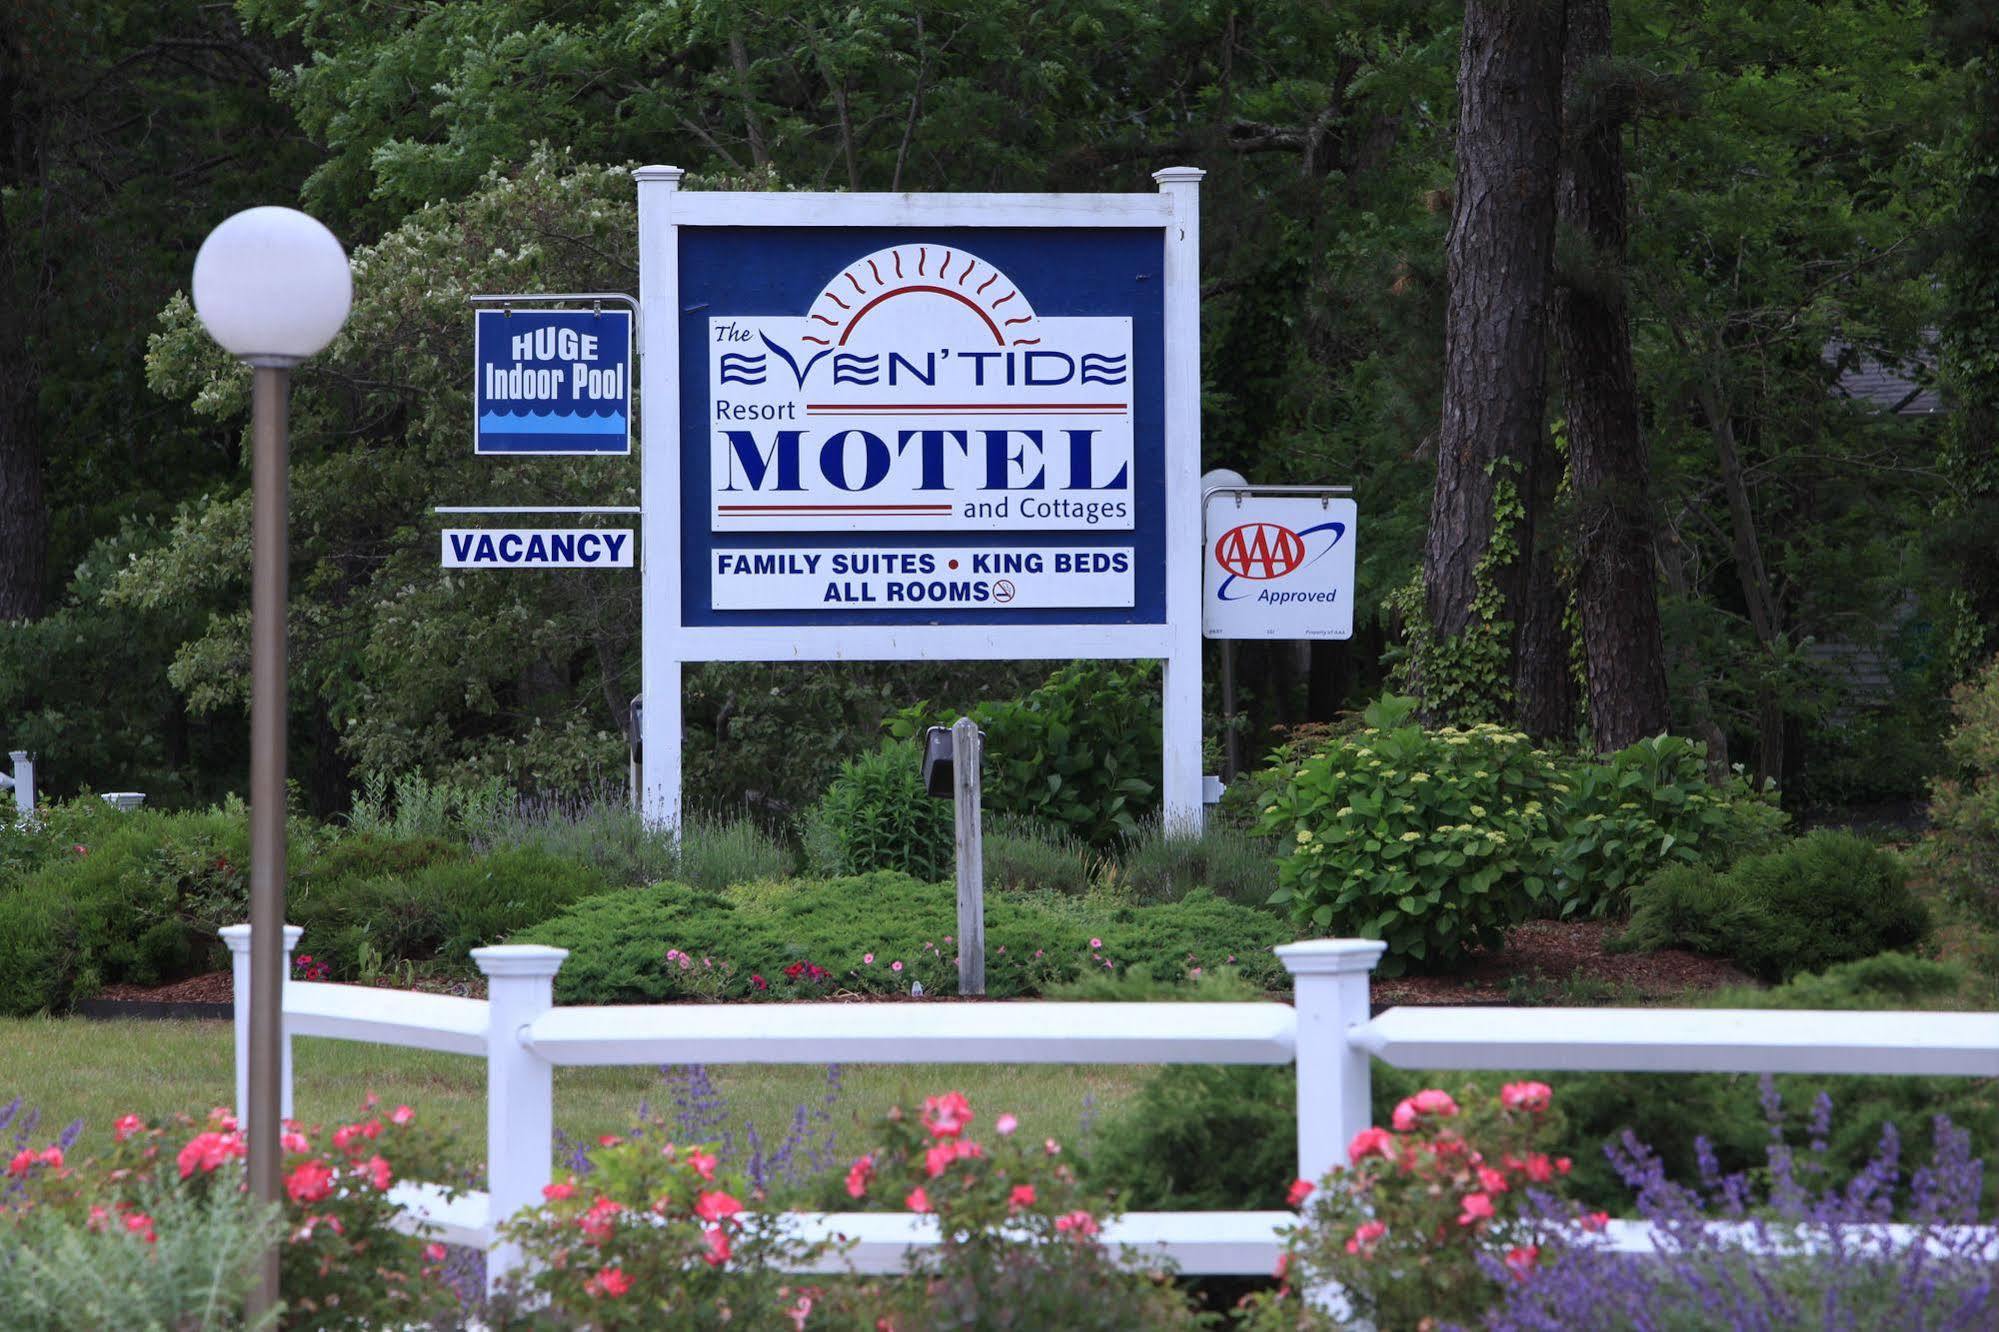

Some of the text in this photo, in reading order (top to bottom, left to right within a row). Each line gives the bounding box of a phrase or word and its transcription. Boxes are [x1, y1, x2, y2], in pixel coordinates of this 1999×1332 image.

[512, 327, 598, 360] HUGE
[715, 321, 753, 343] The
[486, 363, 623, 399] Indoor Pool
[716, 400, 796, 421] Resort
[717, 430, 1128, 491] MOTEL
[964, 497, 1127, 524] and Cottages
[450, 534, 627, 562] VACANCY
[1226, 524, 1296, 579] AAA
[718, 553, 1128, 575] FAMILY SUITES KING BEDS
[824, 582, 990, 602] ALL ROOMS
[1258, 589, 1337, 605] Approved
